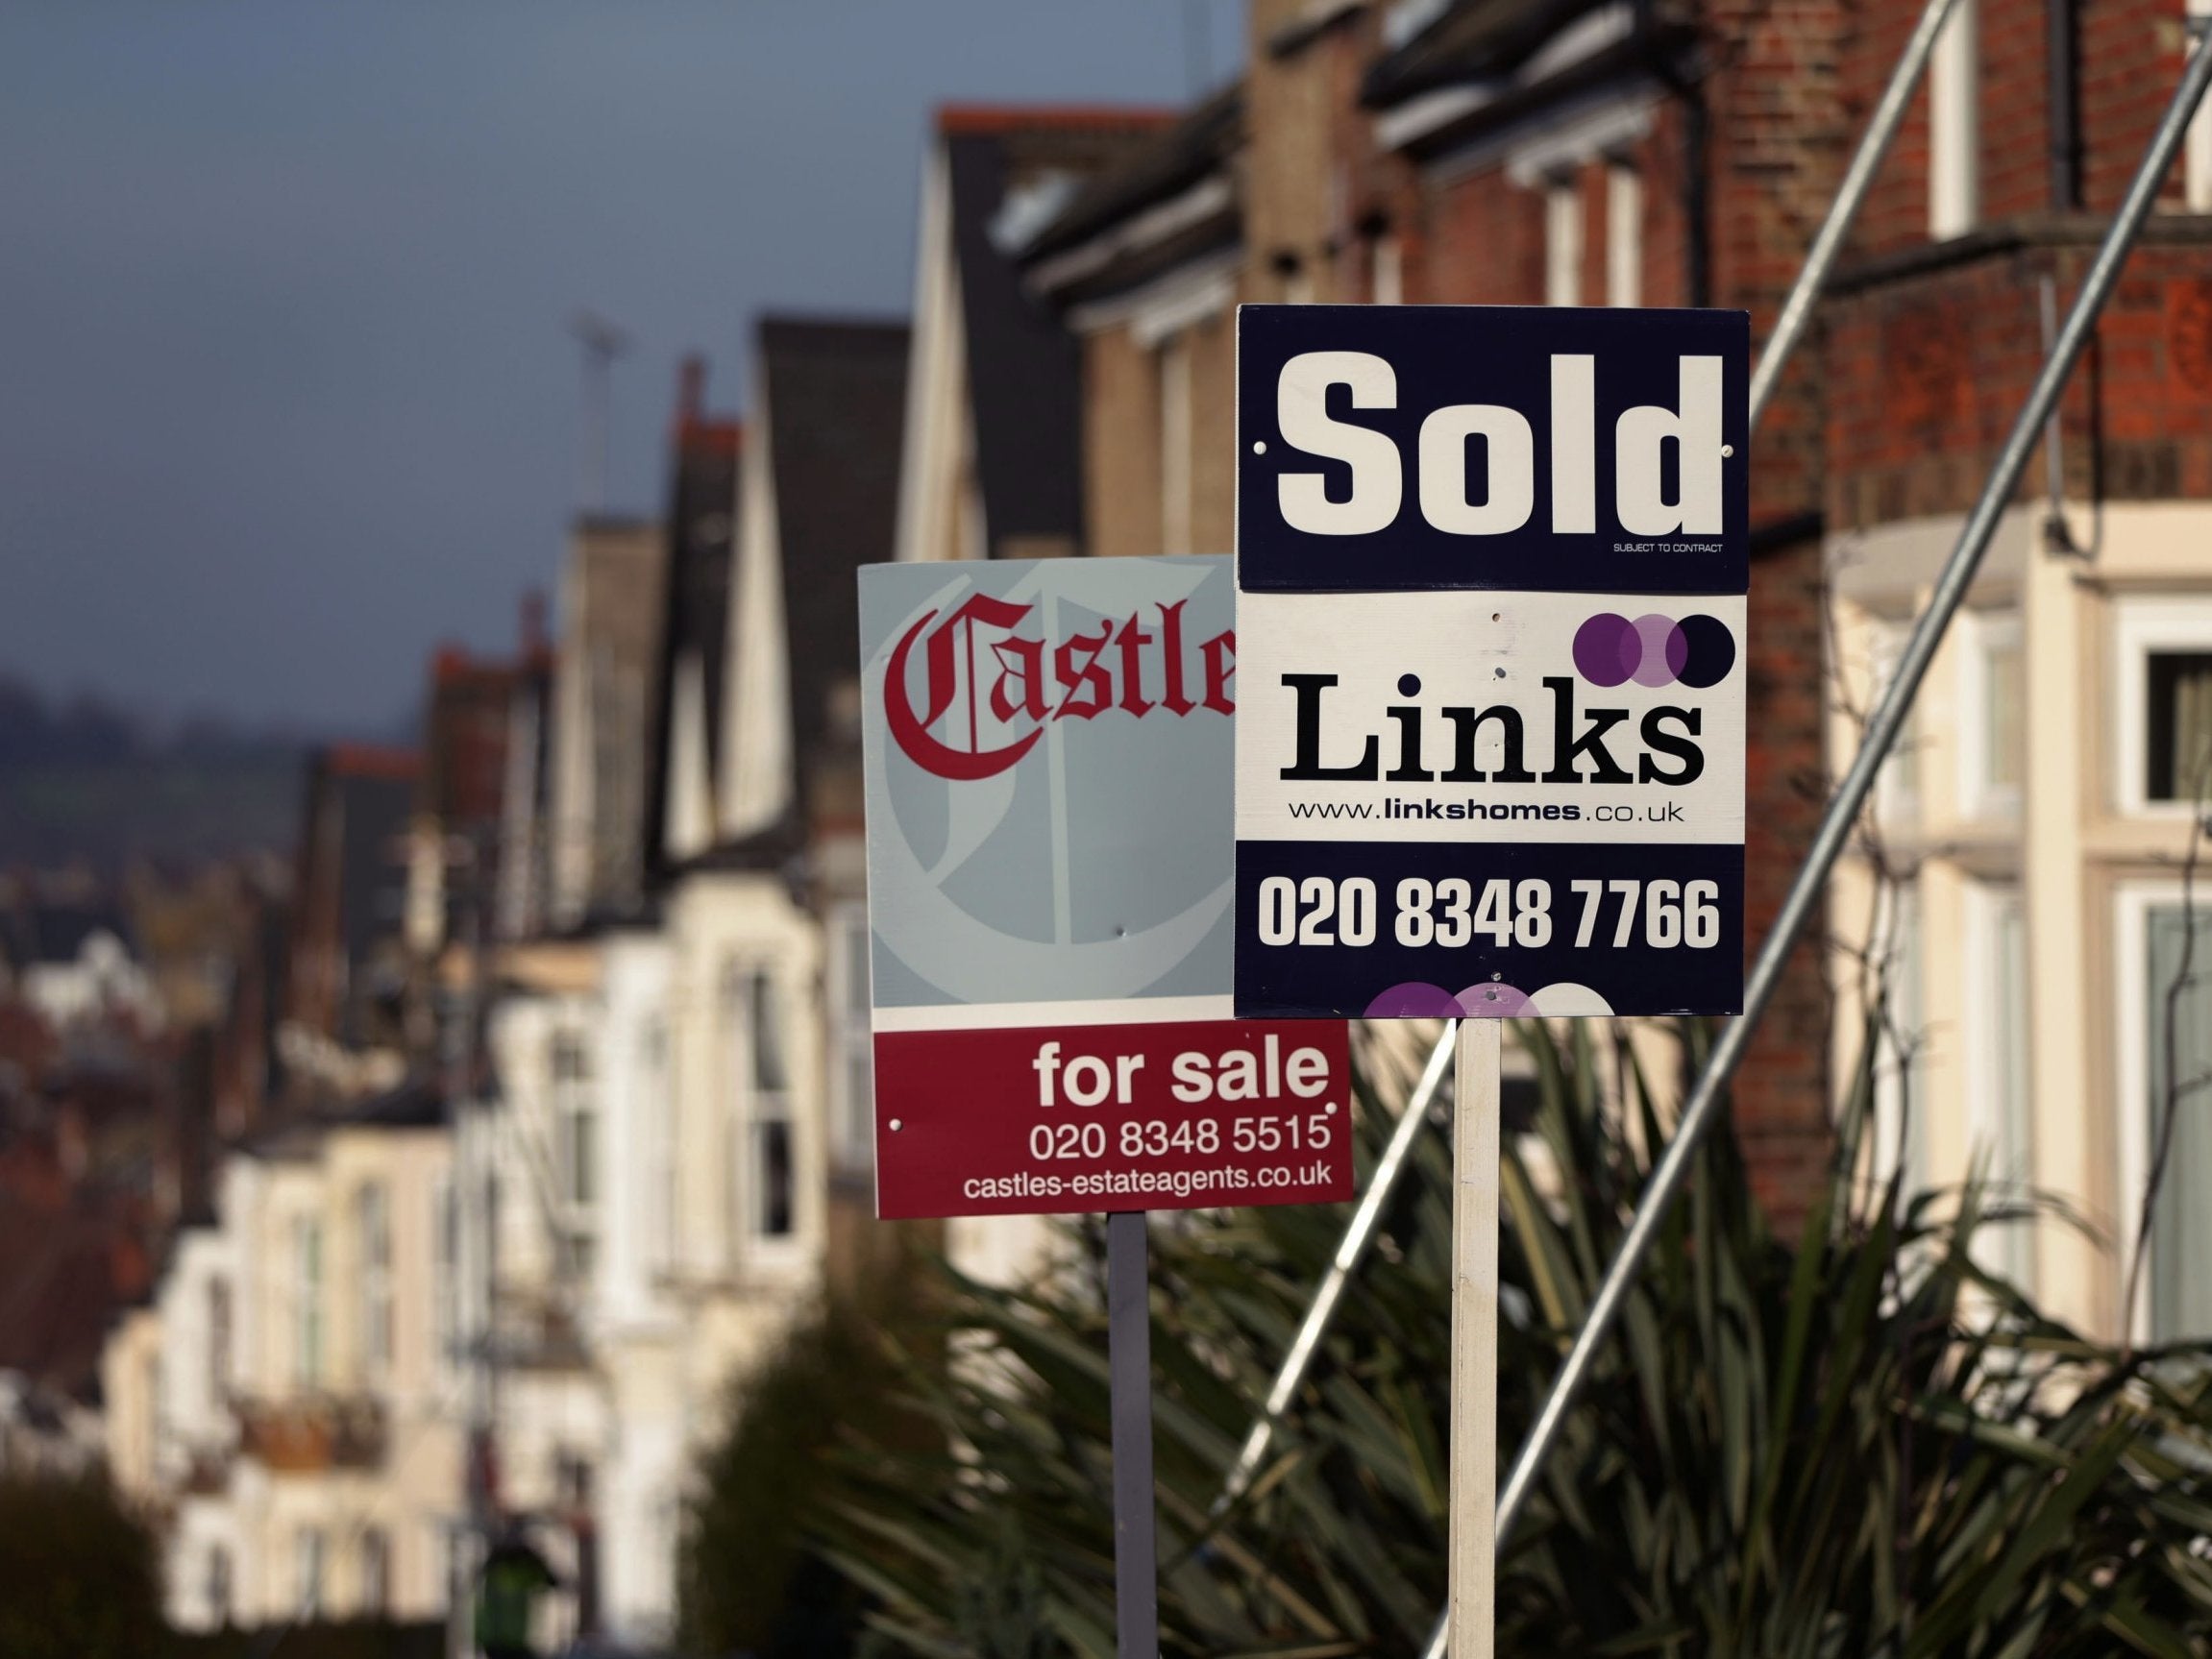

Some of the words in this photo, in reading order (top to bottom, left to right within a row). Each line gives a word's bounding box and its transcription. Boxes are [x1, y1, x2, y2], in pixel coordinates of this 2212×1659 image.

[1277, 351, 1723, 536] Sold
[1613, 543, 1655, 552] SUBJECT
[1658, 543, 1671, 552] TO
[1672, 544, 1723, 553] CONTRACT
[1280, 673, 1705, 786] Links
[1289, 798, 1684, 822] www.linkshomes.co.uk
[1258, 876, 1377, 946] 020
[1394, 877, 1553, 948] 8348
[1570, 878, 1720, 949] 7766
[1032, 1041, 1144, 1107] for
[1170, 1034, 1330, 1103] sale
[1029, 1124, 1106, 1159] 020
[1119, 1117, 1219, 1157] 8348
[1233, 1114, 1332, 1153] 5515
[964, 1160, 1333, 1199] castles-estateagents.co.uk
